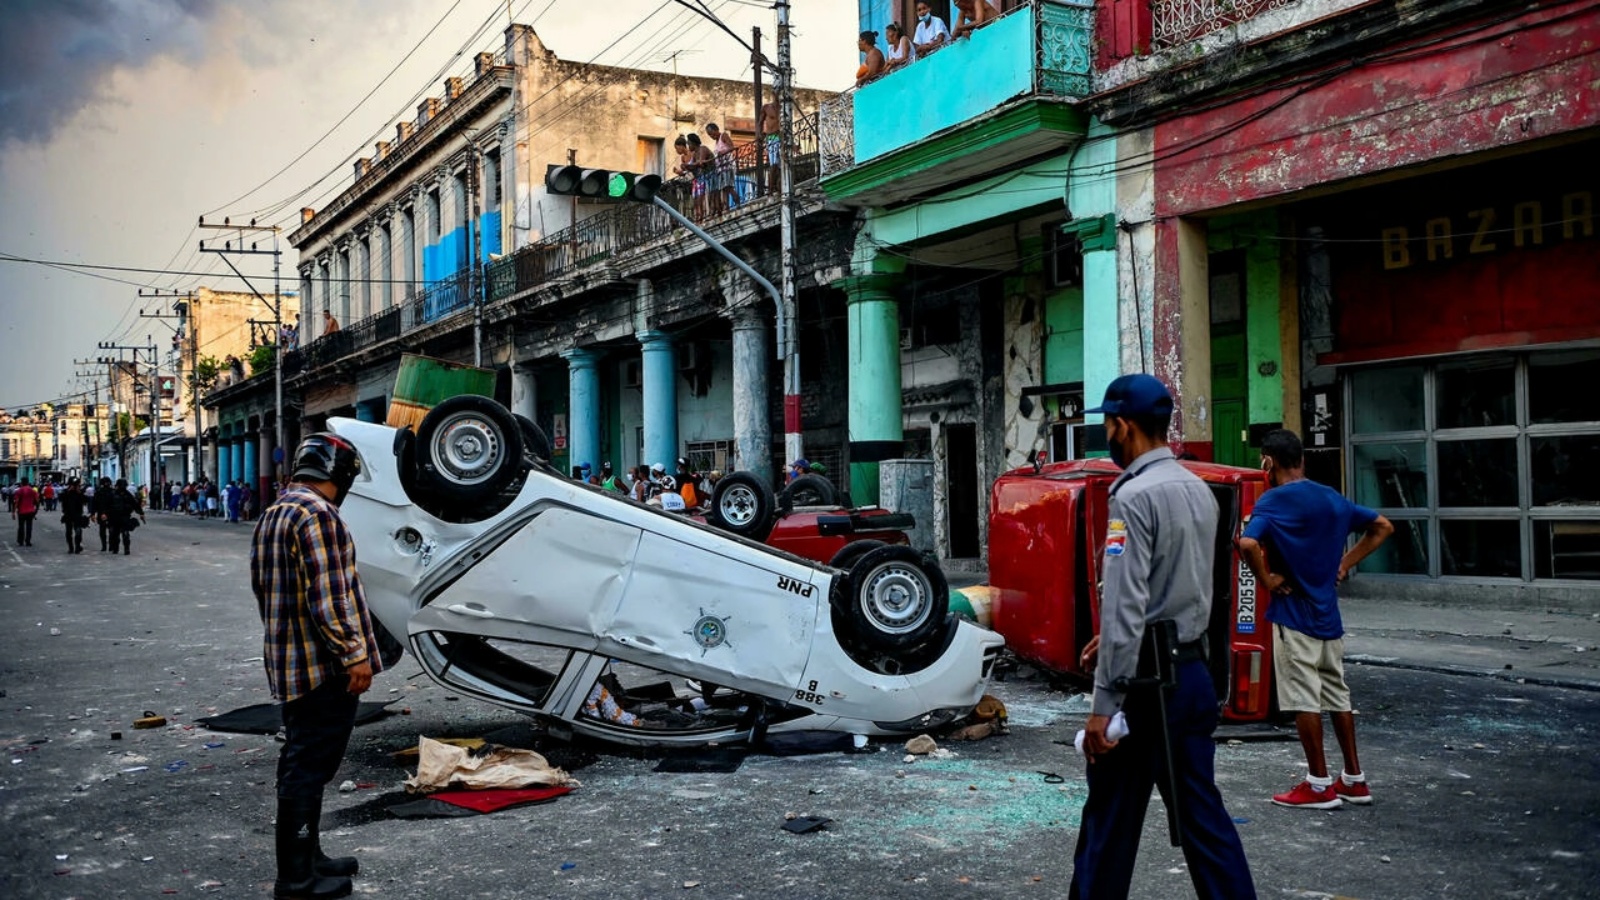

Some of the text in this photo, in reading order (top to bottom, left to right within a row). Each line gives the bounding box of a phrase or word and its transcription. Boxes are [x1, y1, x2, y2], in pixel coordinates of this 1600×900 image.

[777, 576, 813, 598] PNR
[1240, 589, 1254, 612] 205
[808, 680, 818, 691] B
[795, 690, 825, 705] 388
